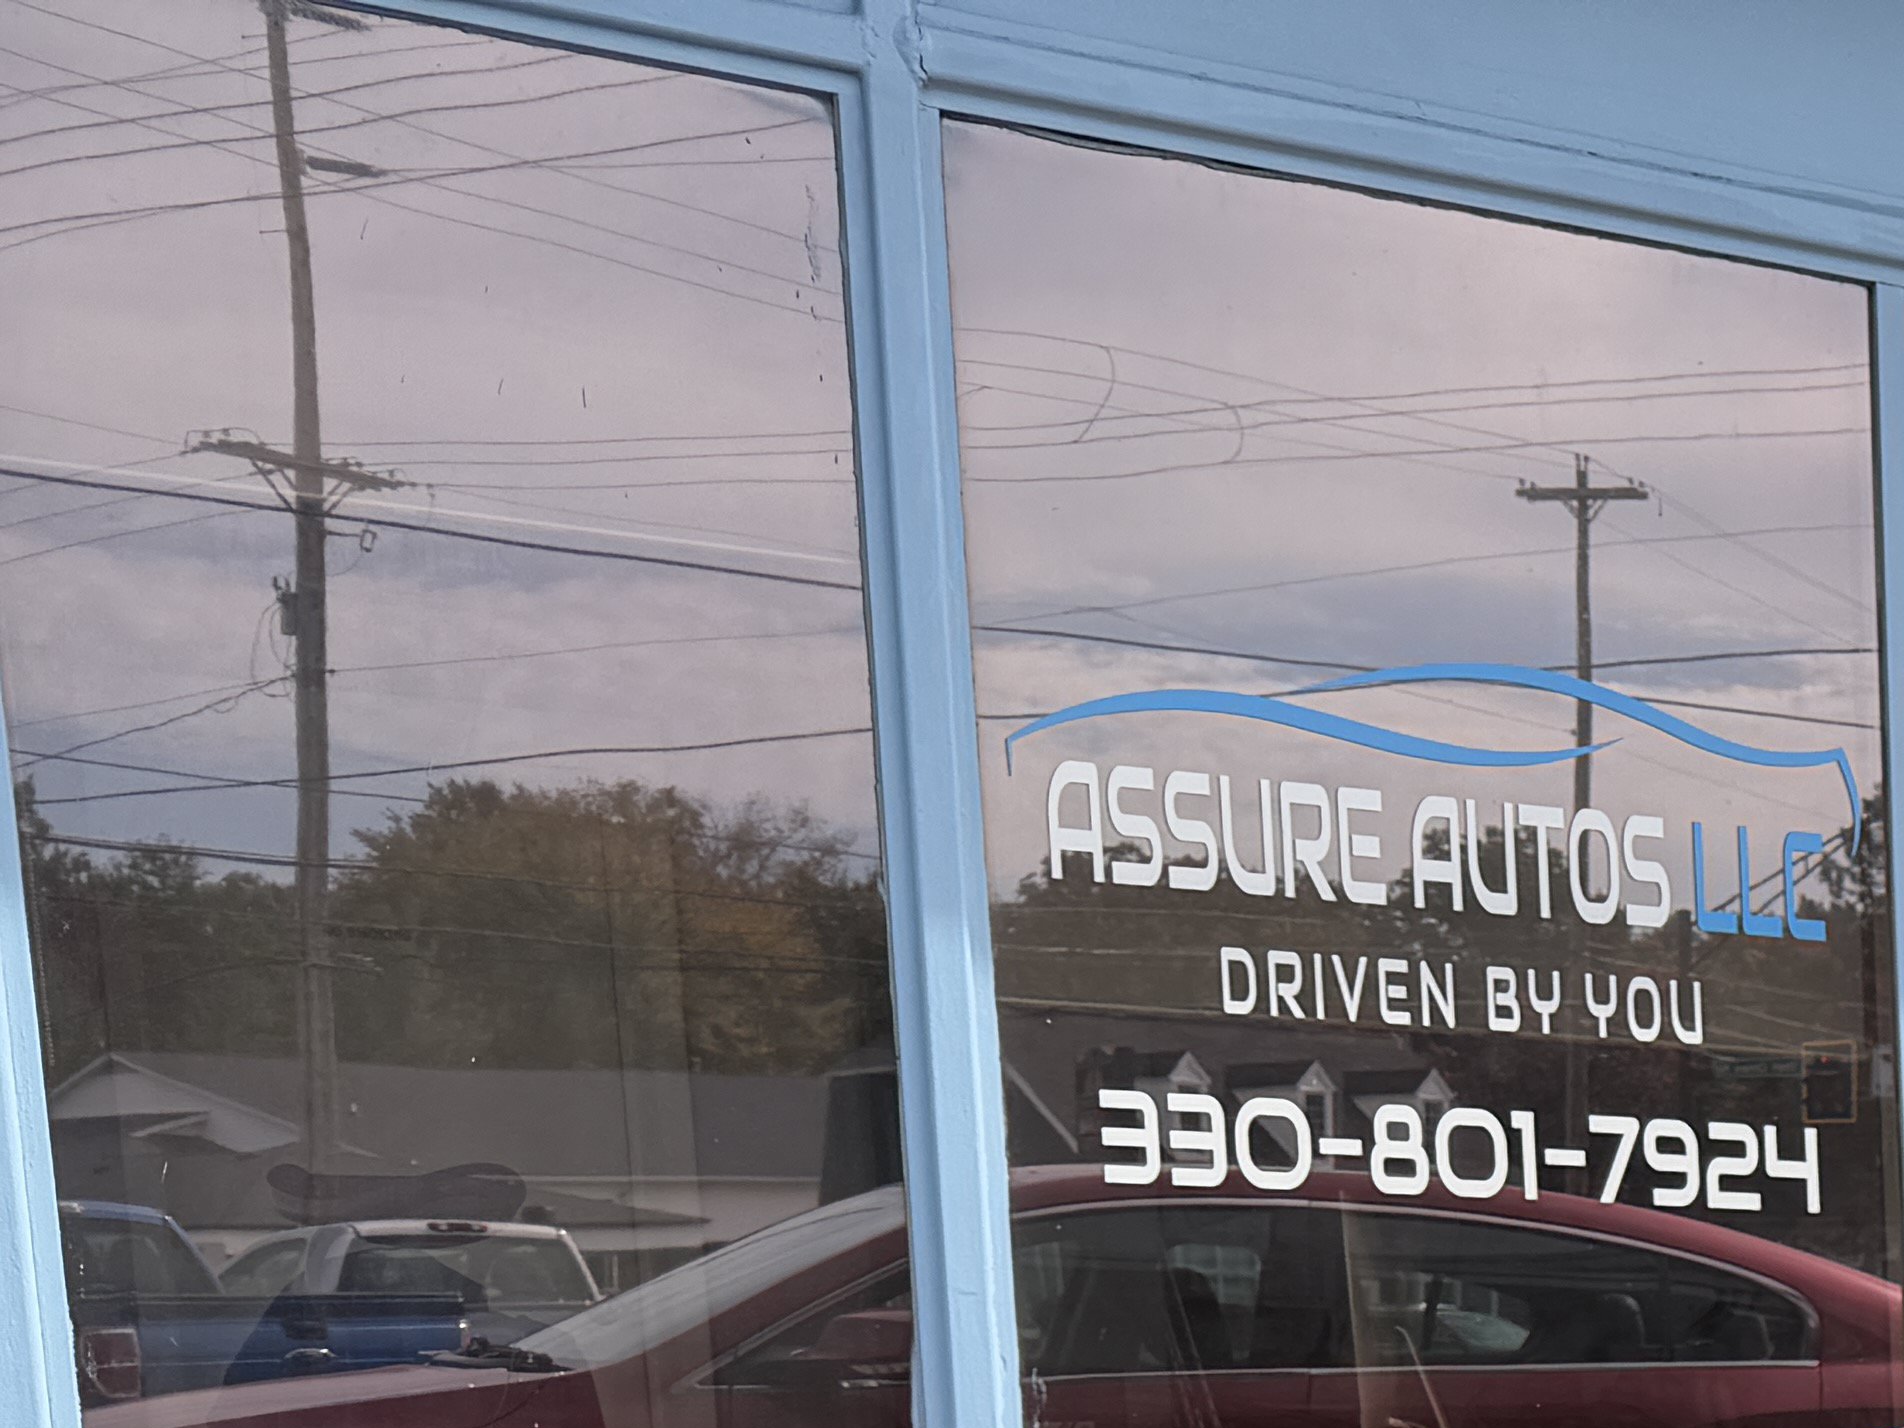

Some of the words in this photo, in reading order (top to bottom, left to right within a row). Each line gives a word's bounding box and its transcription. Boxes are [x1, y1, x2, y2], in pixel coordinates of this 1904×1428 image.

[1046, 760, 1388, 907] ASSURE
[1412, 796, 1671, 929] AUTOS
[1691, 821, 1827, 942] LLC
[1219, 945, 1455, 1030] DRIVEN
[1487, 965, 1562, 1036] BY
[1586, 975, 1704, 1045] YOU
[1098, 1088, 1821, 1215] 330-801-7924
